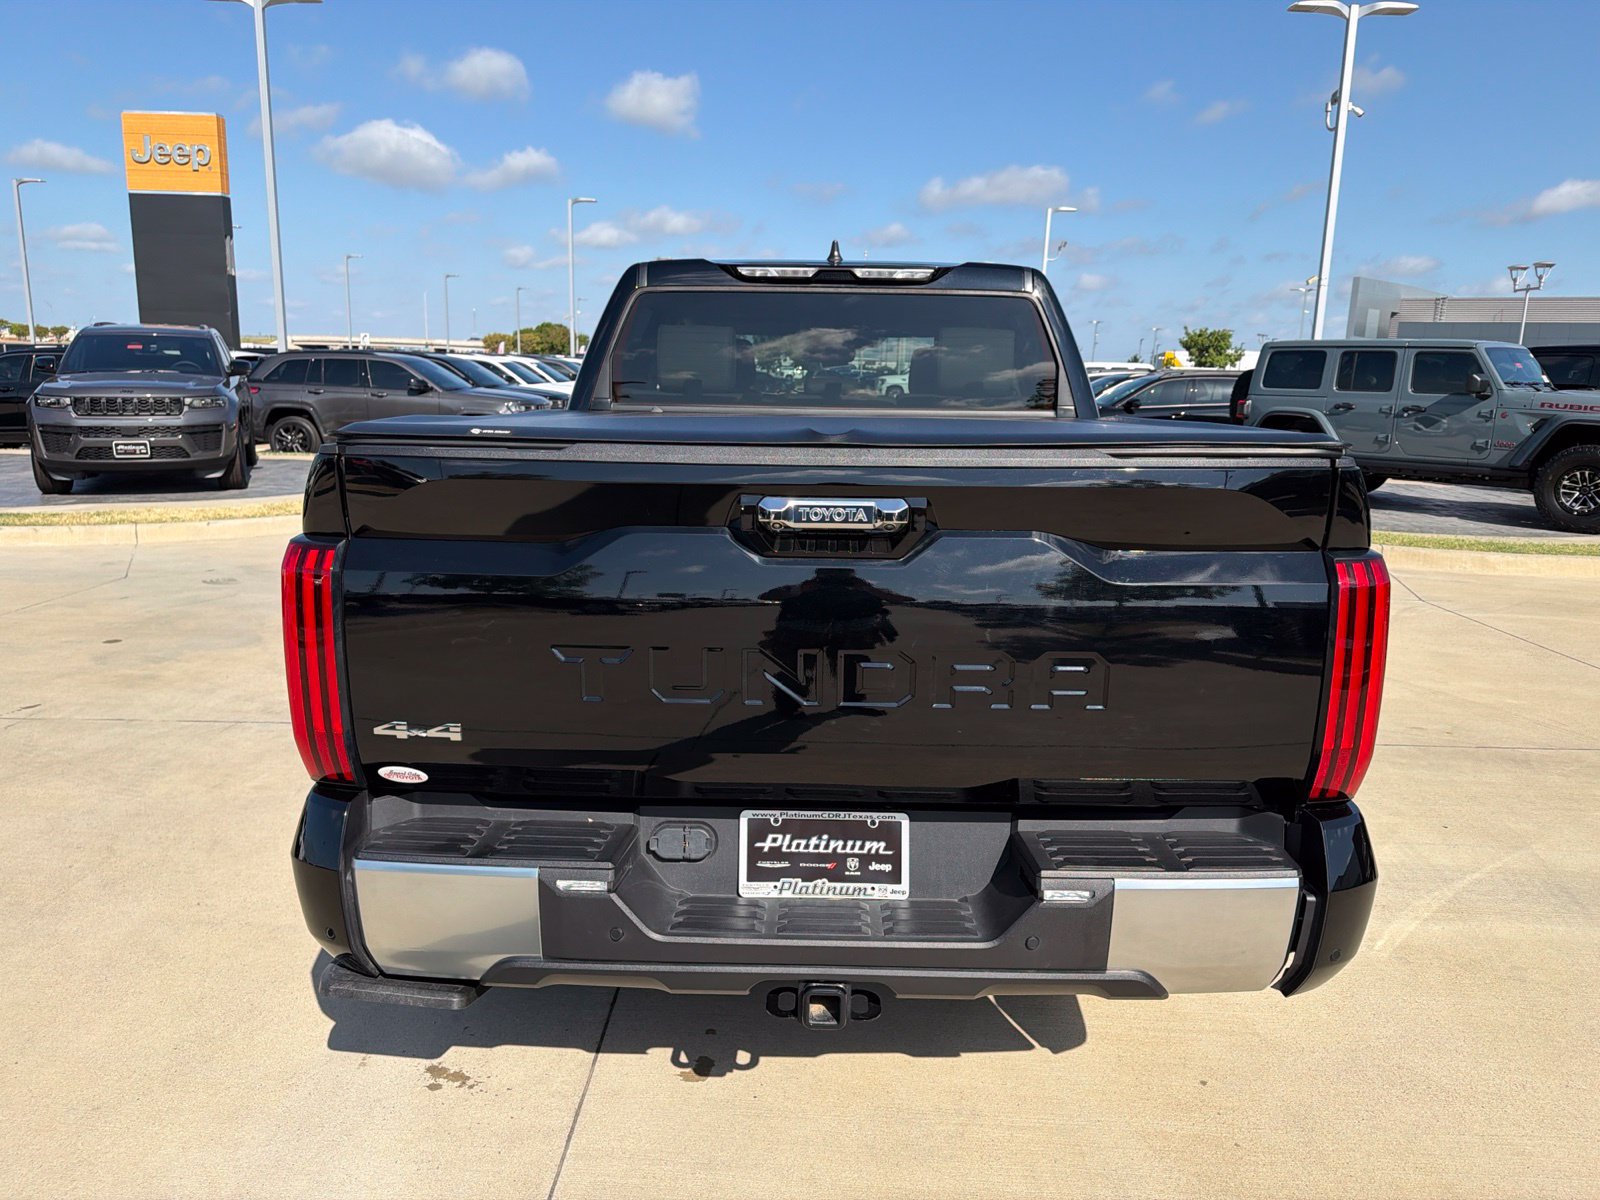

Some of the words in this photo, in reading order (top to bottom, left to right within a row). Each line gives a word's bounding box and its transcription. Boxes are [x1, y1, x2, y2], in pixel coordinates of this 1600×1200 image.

[130, 134, 211, 172] Jeep
[798, 507, 868, 522] TOYOTA
[550, 645, 1110, 710] TUNDRA
[751, 811, 897, 820] www.PlatinumCDRJTexas.com
[754, 833, 895, 854] Platinum
[868, 861, 892, 873] Jeep
[777, 879, 875, 897] Platinum
